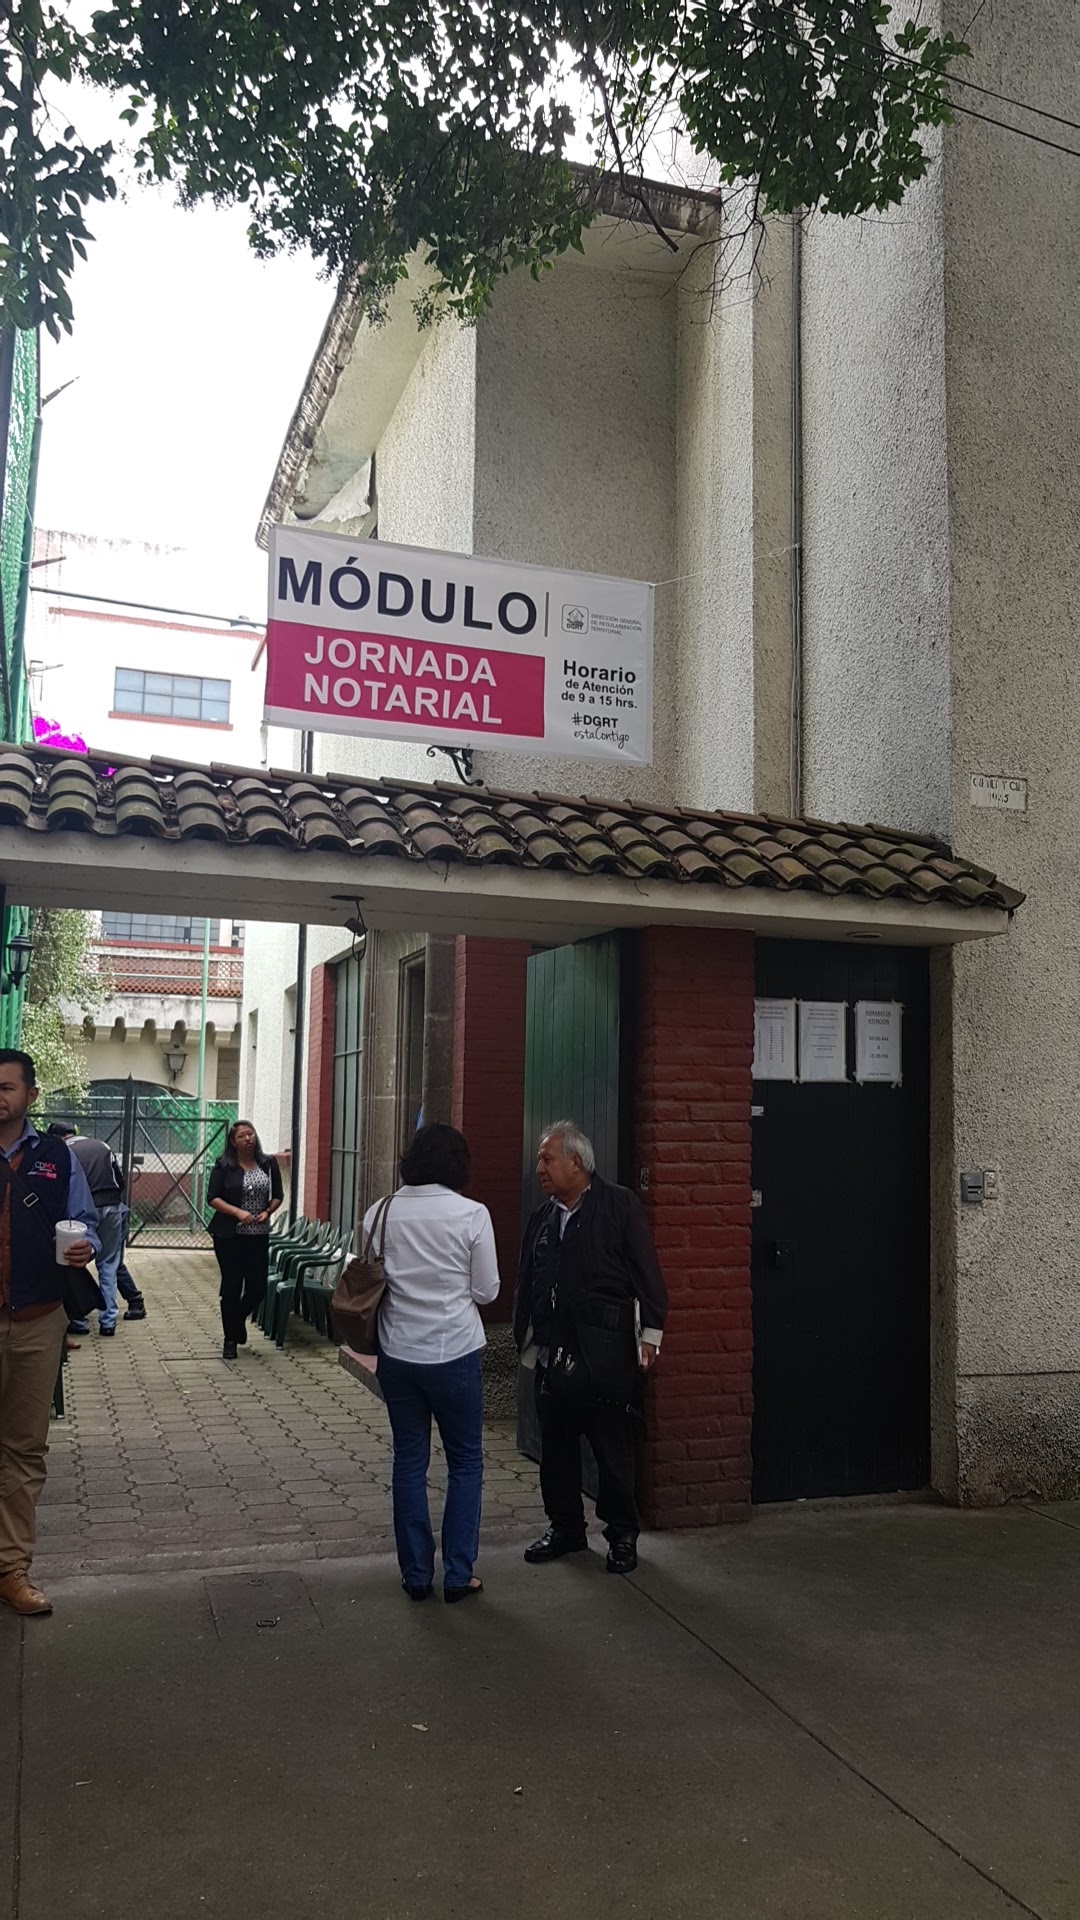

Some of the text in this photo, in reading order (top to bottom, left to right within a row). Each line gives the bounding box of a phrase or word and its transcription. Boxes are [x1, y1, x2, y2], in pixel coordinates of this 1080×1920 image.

[278, 556, 537, 635] MÓDULO
[591, 613, 642, 625] DIRECCIÓN GENERAL
[599, 621, 642, 631] REGULARIZACIÓN
[591, 626, 622, 635] TERRITORIAL
[304, 636, 496, 687] JORNADA
[563, 659, 636, 683] Horario
[565, 679, 634, 696] de Atención
[304, 672, 502, 725] NOTARIAL
[561, 691, 638, 709] de 9 a 15 hrs.
[571, 712, 618, 729] #DGRT
[34, 1161, 57, 1170] CDMX
